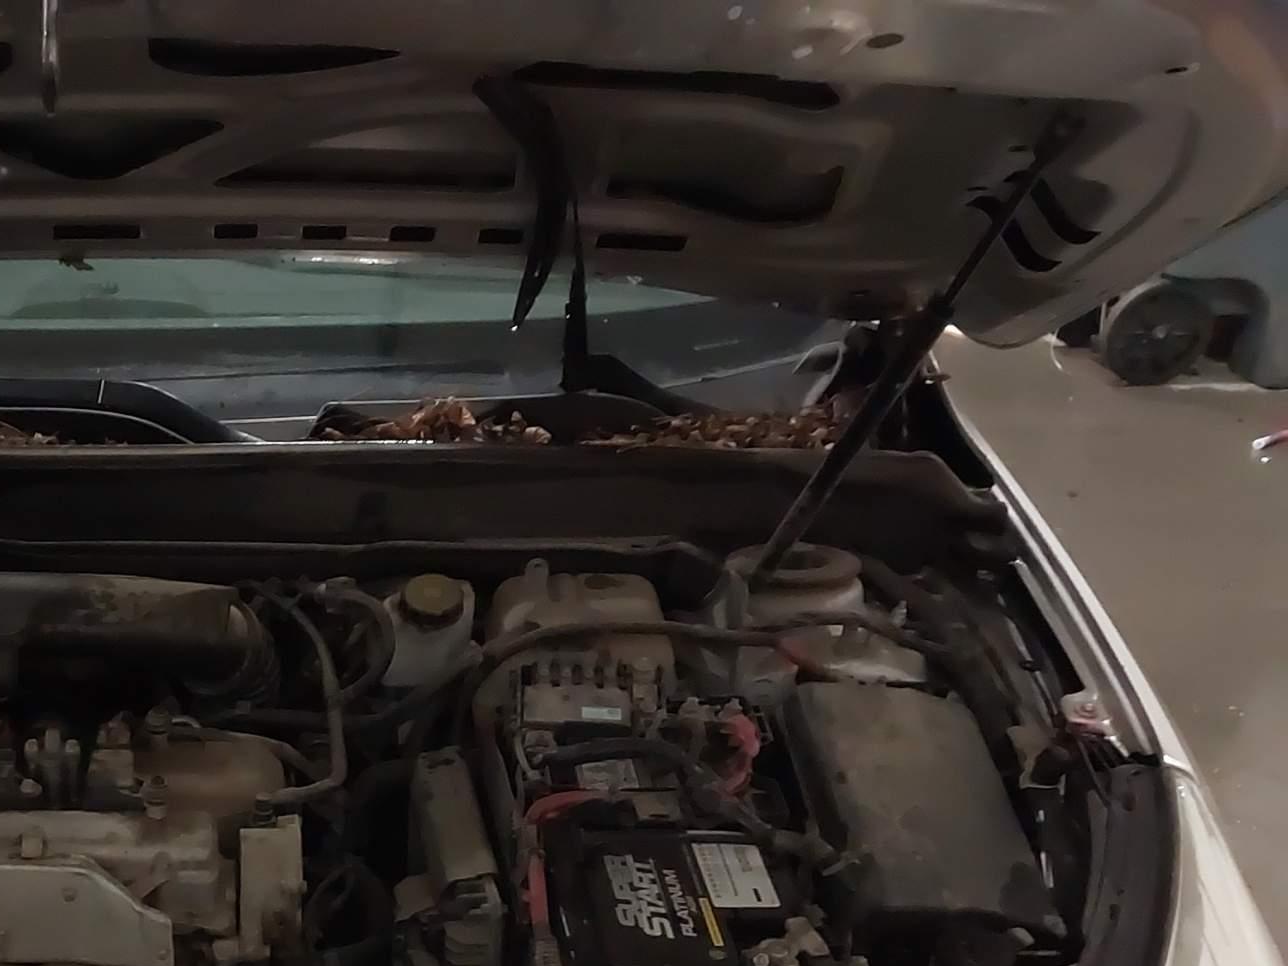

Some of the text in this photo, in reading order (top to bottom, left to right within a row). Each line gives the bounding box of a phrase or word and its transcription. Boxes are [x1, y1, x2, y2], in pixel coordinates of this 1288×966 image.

[603, 854, 637, 926] SUPER
[634, 857, 676, 939] START
[662, 869, 698, 937] PLATINUM
